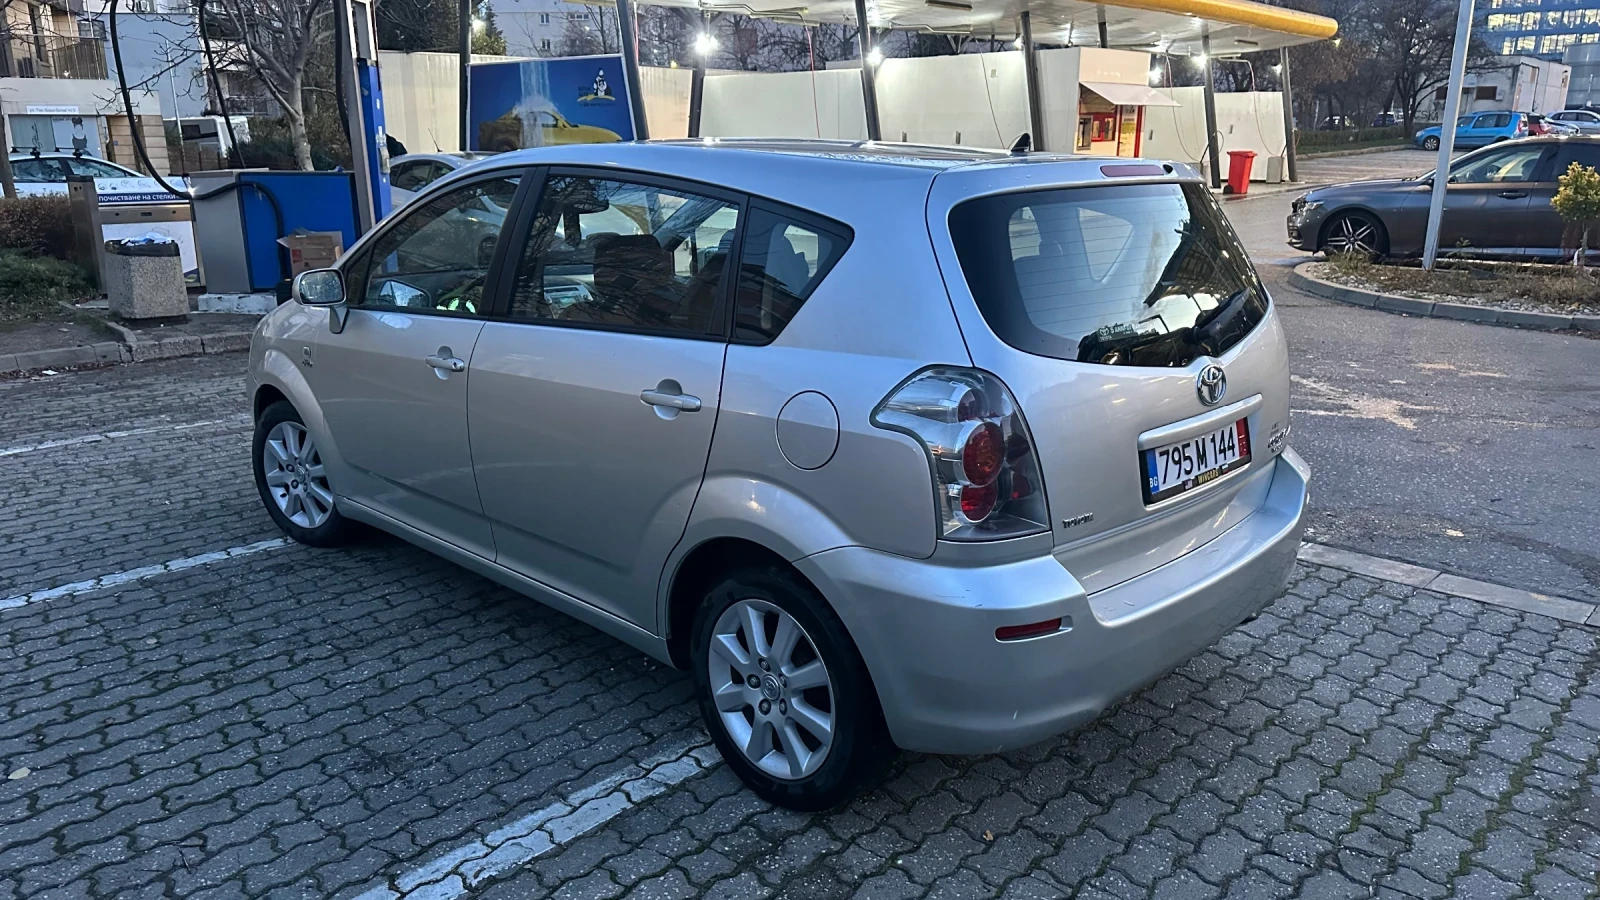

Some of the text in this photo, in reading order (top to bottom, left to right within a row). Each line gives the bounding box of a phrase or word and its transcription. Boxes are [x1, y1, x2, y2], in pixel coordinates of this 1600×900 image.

[98, 194, 141, 202] почистване
[1159, 442, 1194, 485] 795
[1195, 436, 1208, 472] M
[1210, 426, 1236, 465] 144
[1149, 476, 1158, 488] BG
[1062, 512, 1094, 529] TOYOTA
